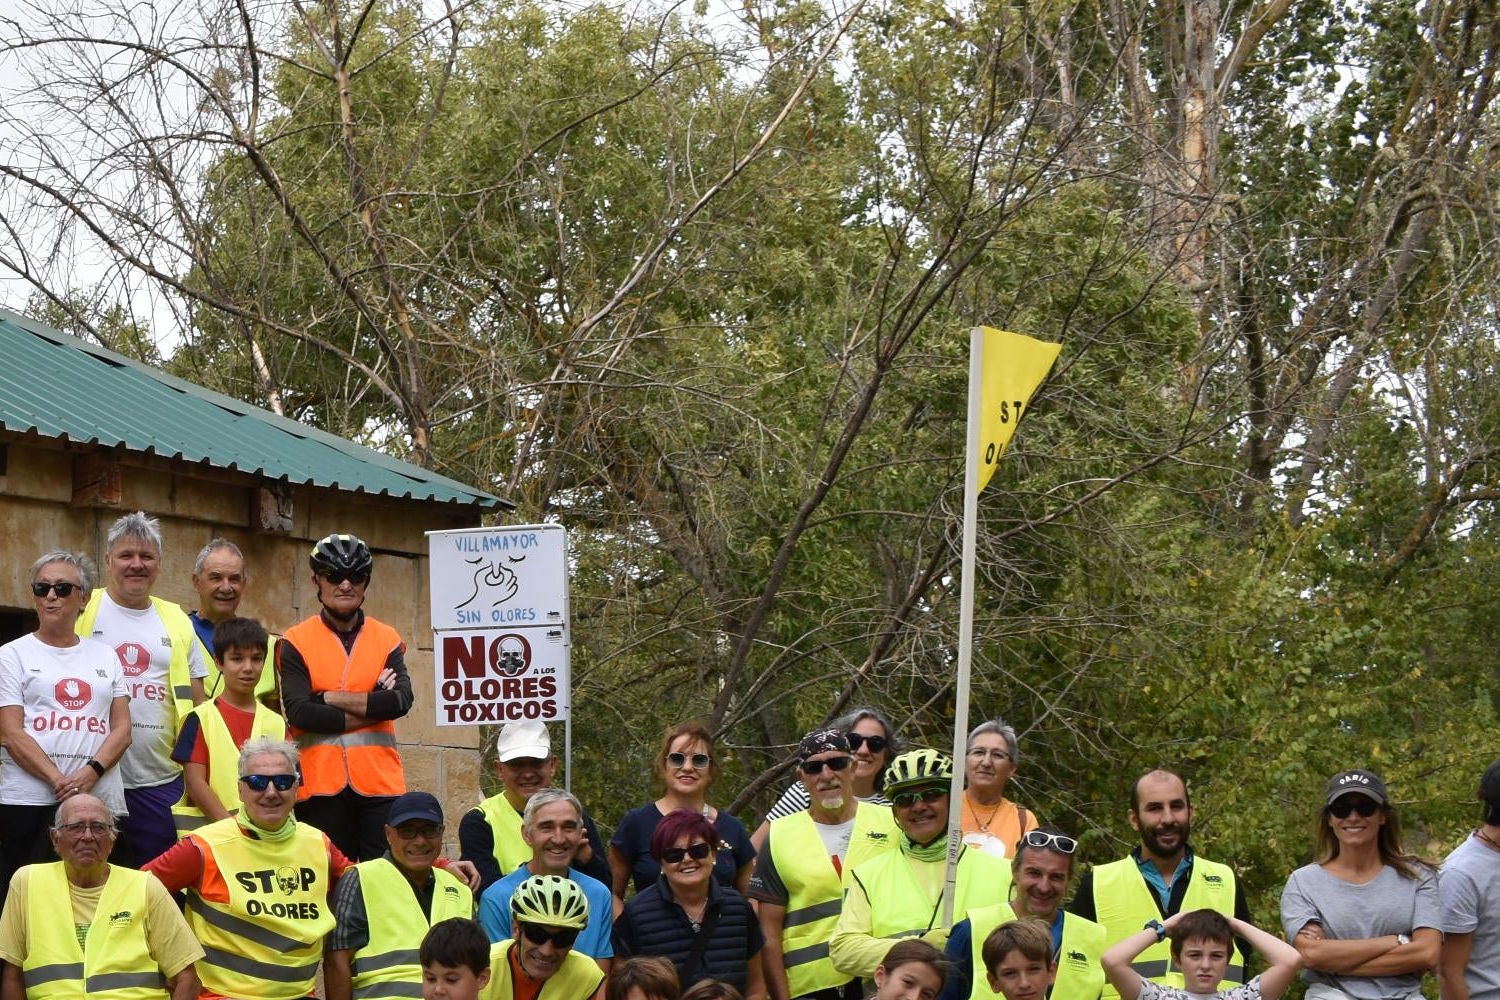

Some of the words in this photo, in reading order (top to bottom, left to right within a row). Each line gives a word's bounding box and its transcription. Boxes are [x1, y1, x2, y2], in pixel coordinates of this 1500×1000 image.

[1001, 400, 1022, 424] ST
[455, 533, 539, 552] VILLAMAYOR
[457, 609, 481, 624] SIN
[491, 608, 536, 623] OLORES
[443, 633, 532, 679] NO
[533, 667, 540, 675] A
[126, 682, 166, 701] res
[441, 676, 557, 702] OLORES
[63, 699, 85, 708] STOP
[444, 699, 558, 723] TÓXICOS
[33, 711, 107, 735] olores
[1339, 774, 1369, 785] PARIS
[246, 899, 320, 920] OLORES
